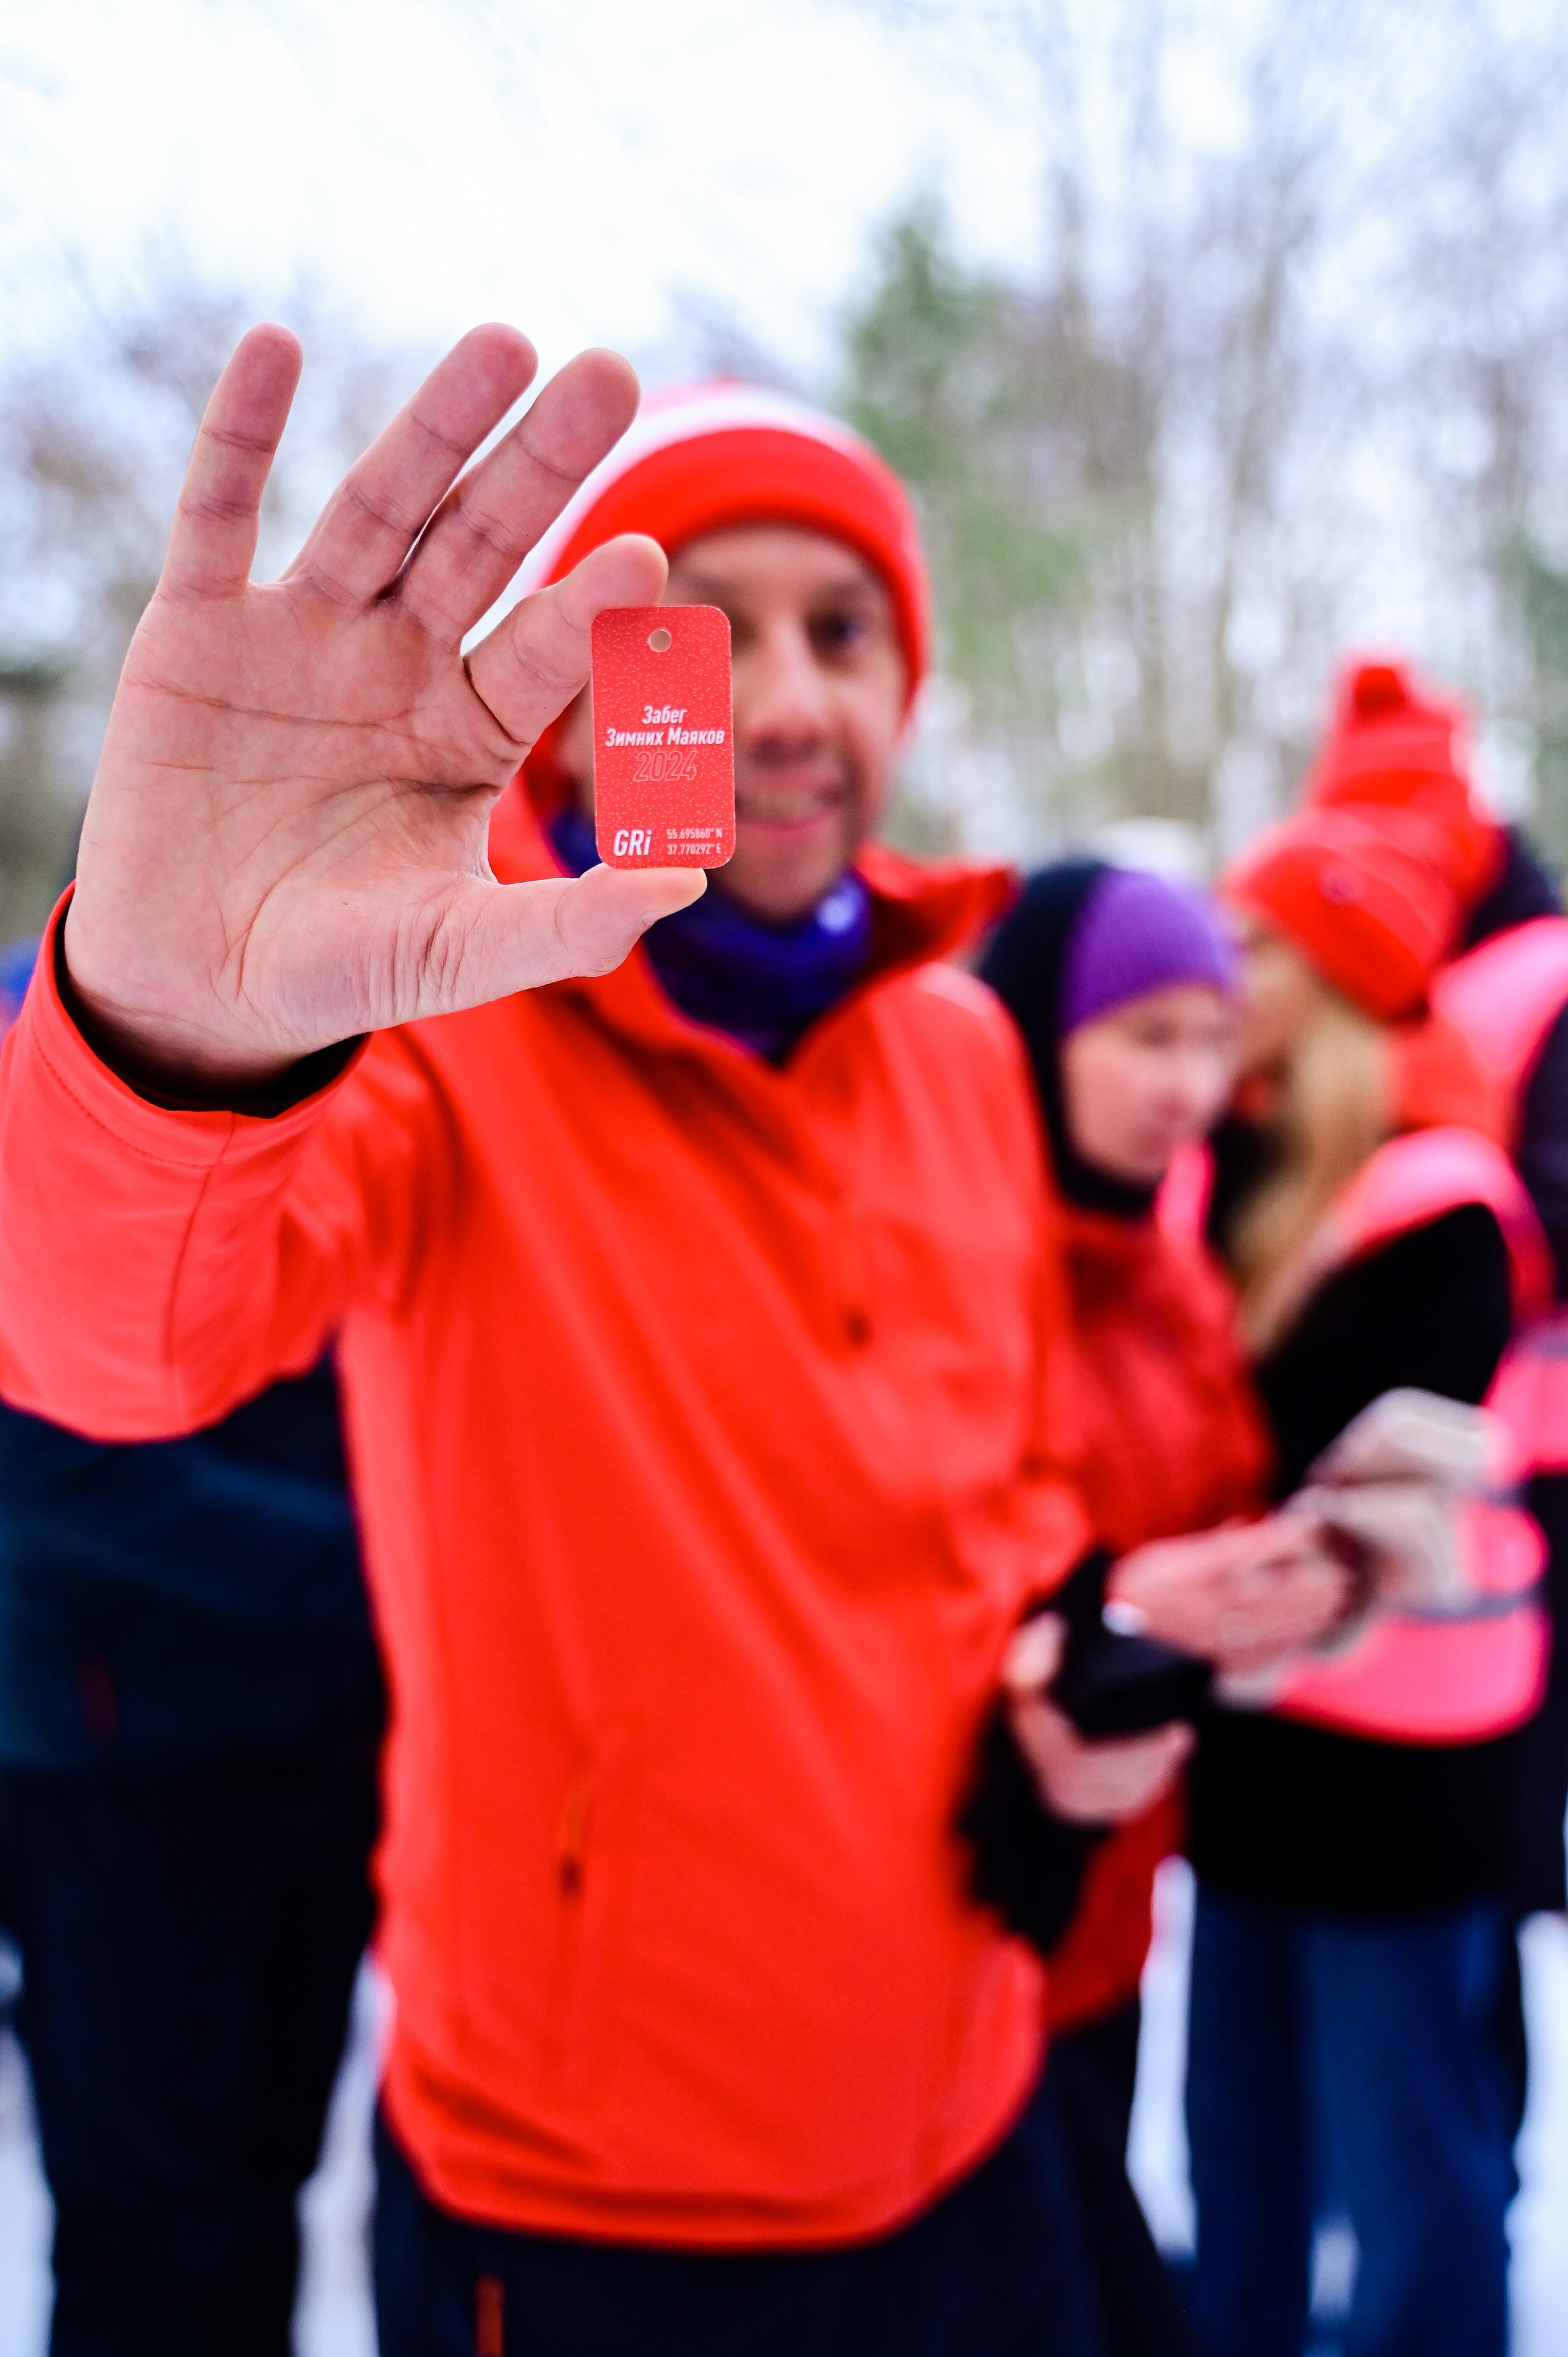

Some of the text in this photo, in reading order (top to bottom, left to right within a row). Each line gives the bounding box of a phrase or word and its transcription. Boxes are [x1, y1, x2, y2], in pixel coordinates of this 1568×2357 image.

[643, 705, 688, 725] Забег
[605, 727, 725, 747] Зимних Маяков
[633, 750, 698, 782] 2024
[614, 829, 652, 856] GRi
[716, 828, 722, 838] N
[716, 843, 722, 854] E
